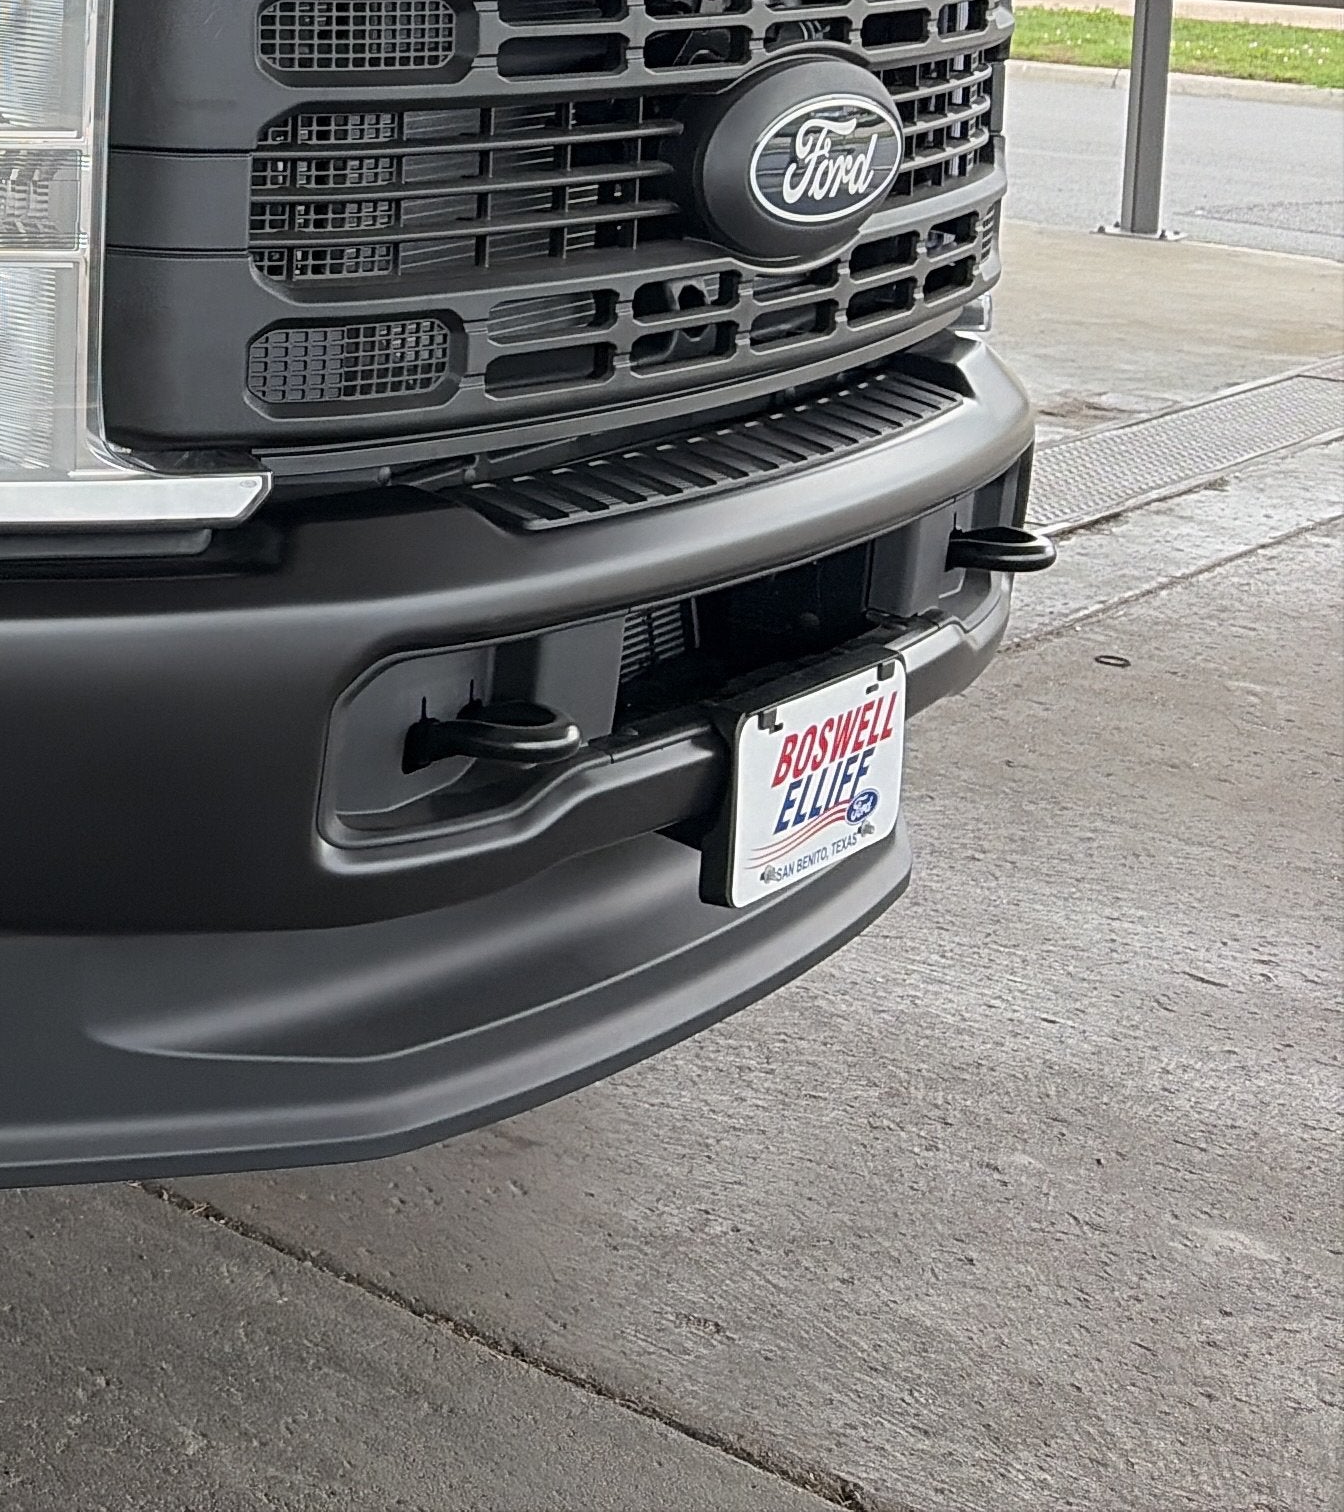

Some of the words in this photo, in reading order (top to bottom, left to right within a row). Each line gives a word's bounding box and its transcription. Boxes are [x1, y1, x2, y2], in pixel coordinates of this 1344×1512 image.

[782, 117, 879, 205] Ford
[771, 690, 898, 789] BOSWELL
[773, 746, 876, 836] ELLIFF
[776, 863, 795, 881] SAN
[796, 844, 831, 874] BENITO,
[830, 832, 858, 856] TEXAS
